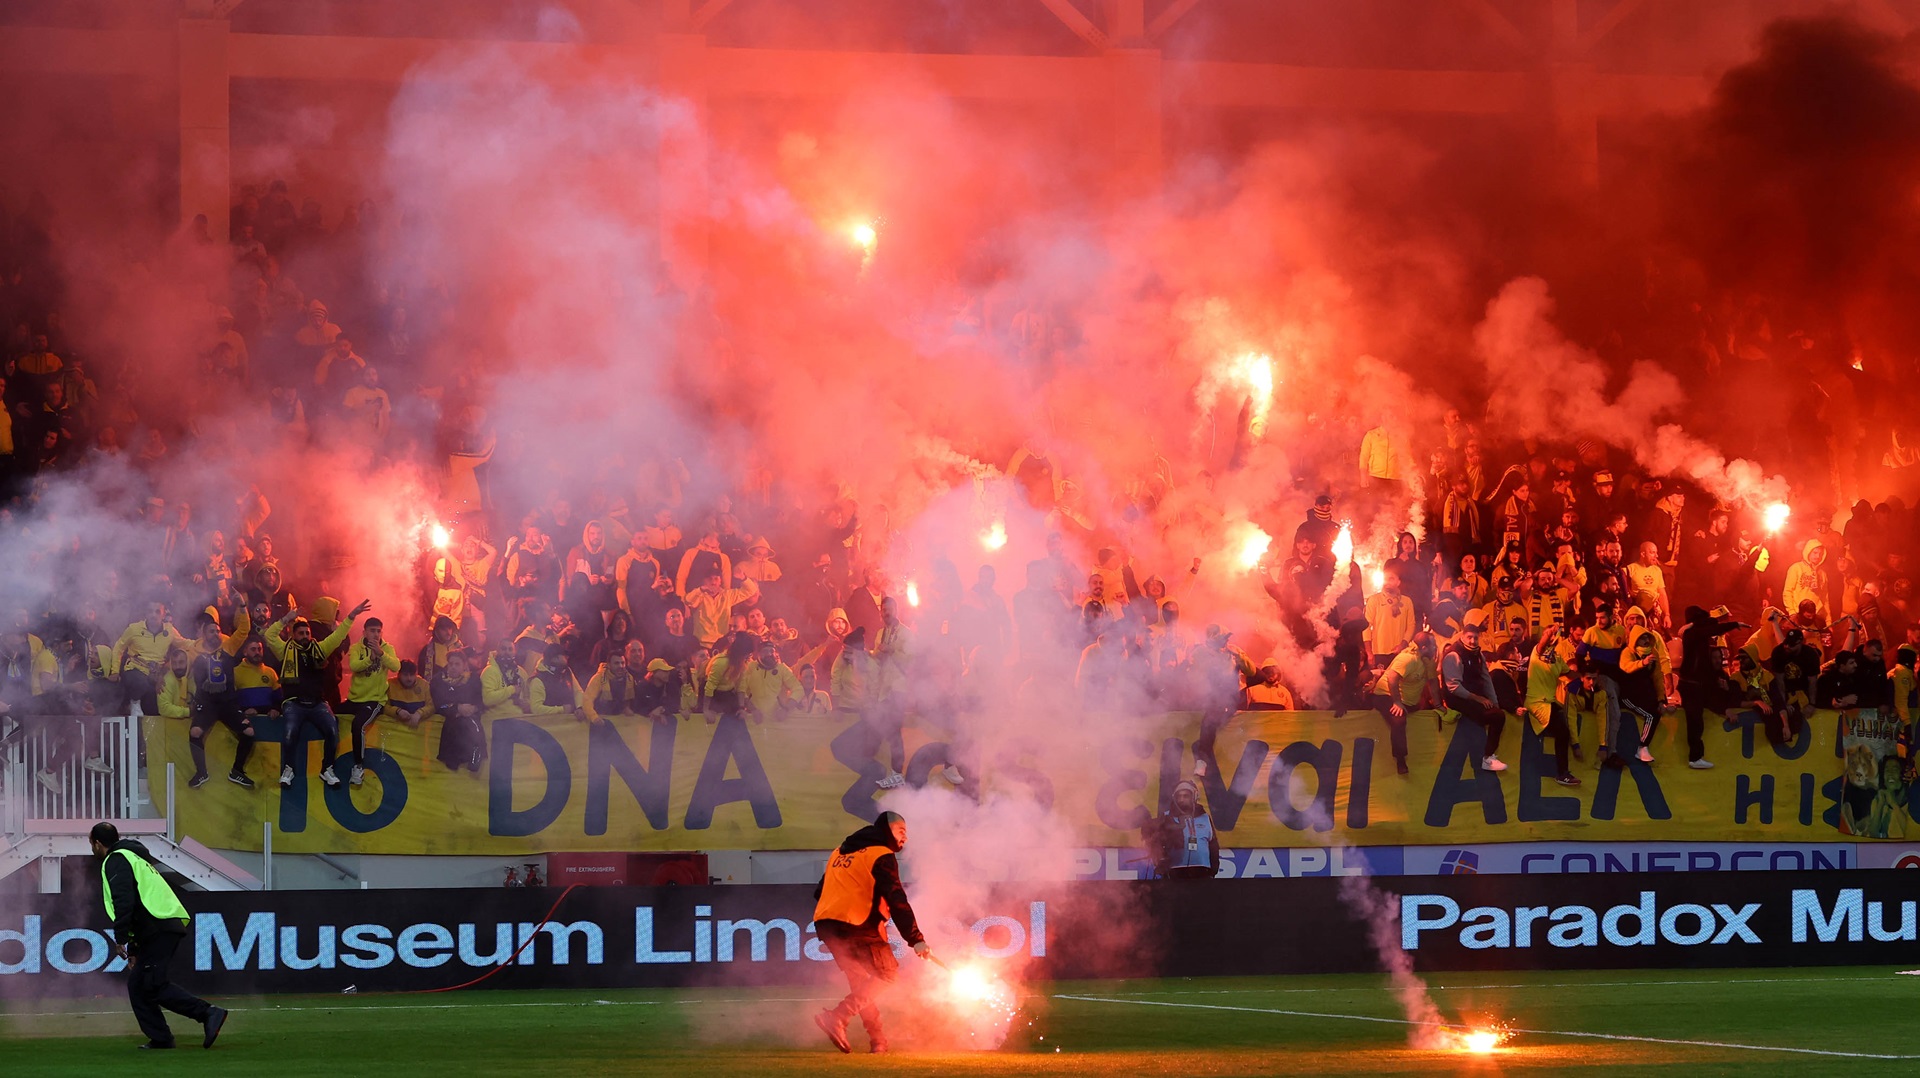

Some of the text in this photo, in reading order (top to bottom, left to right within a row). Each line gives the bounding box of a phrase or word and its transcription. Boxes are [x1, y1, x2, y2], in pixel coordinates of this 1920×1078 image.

[488, 714, 782, 836] DNA
[194, 912, 604, 972] Museum
[635, 901, 1047, 964] Limaol
[1400, 891, 1763, 950] Paradox
